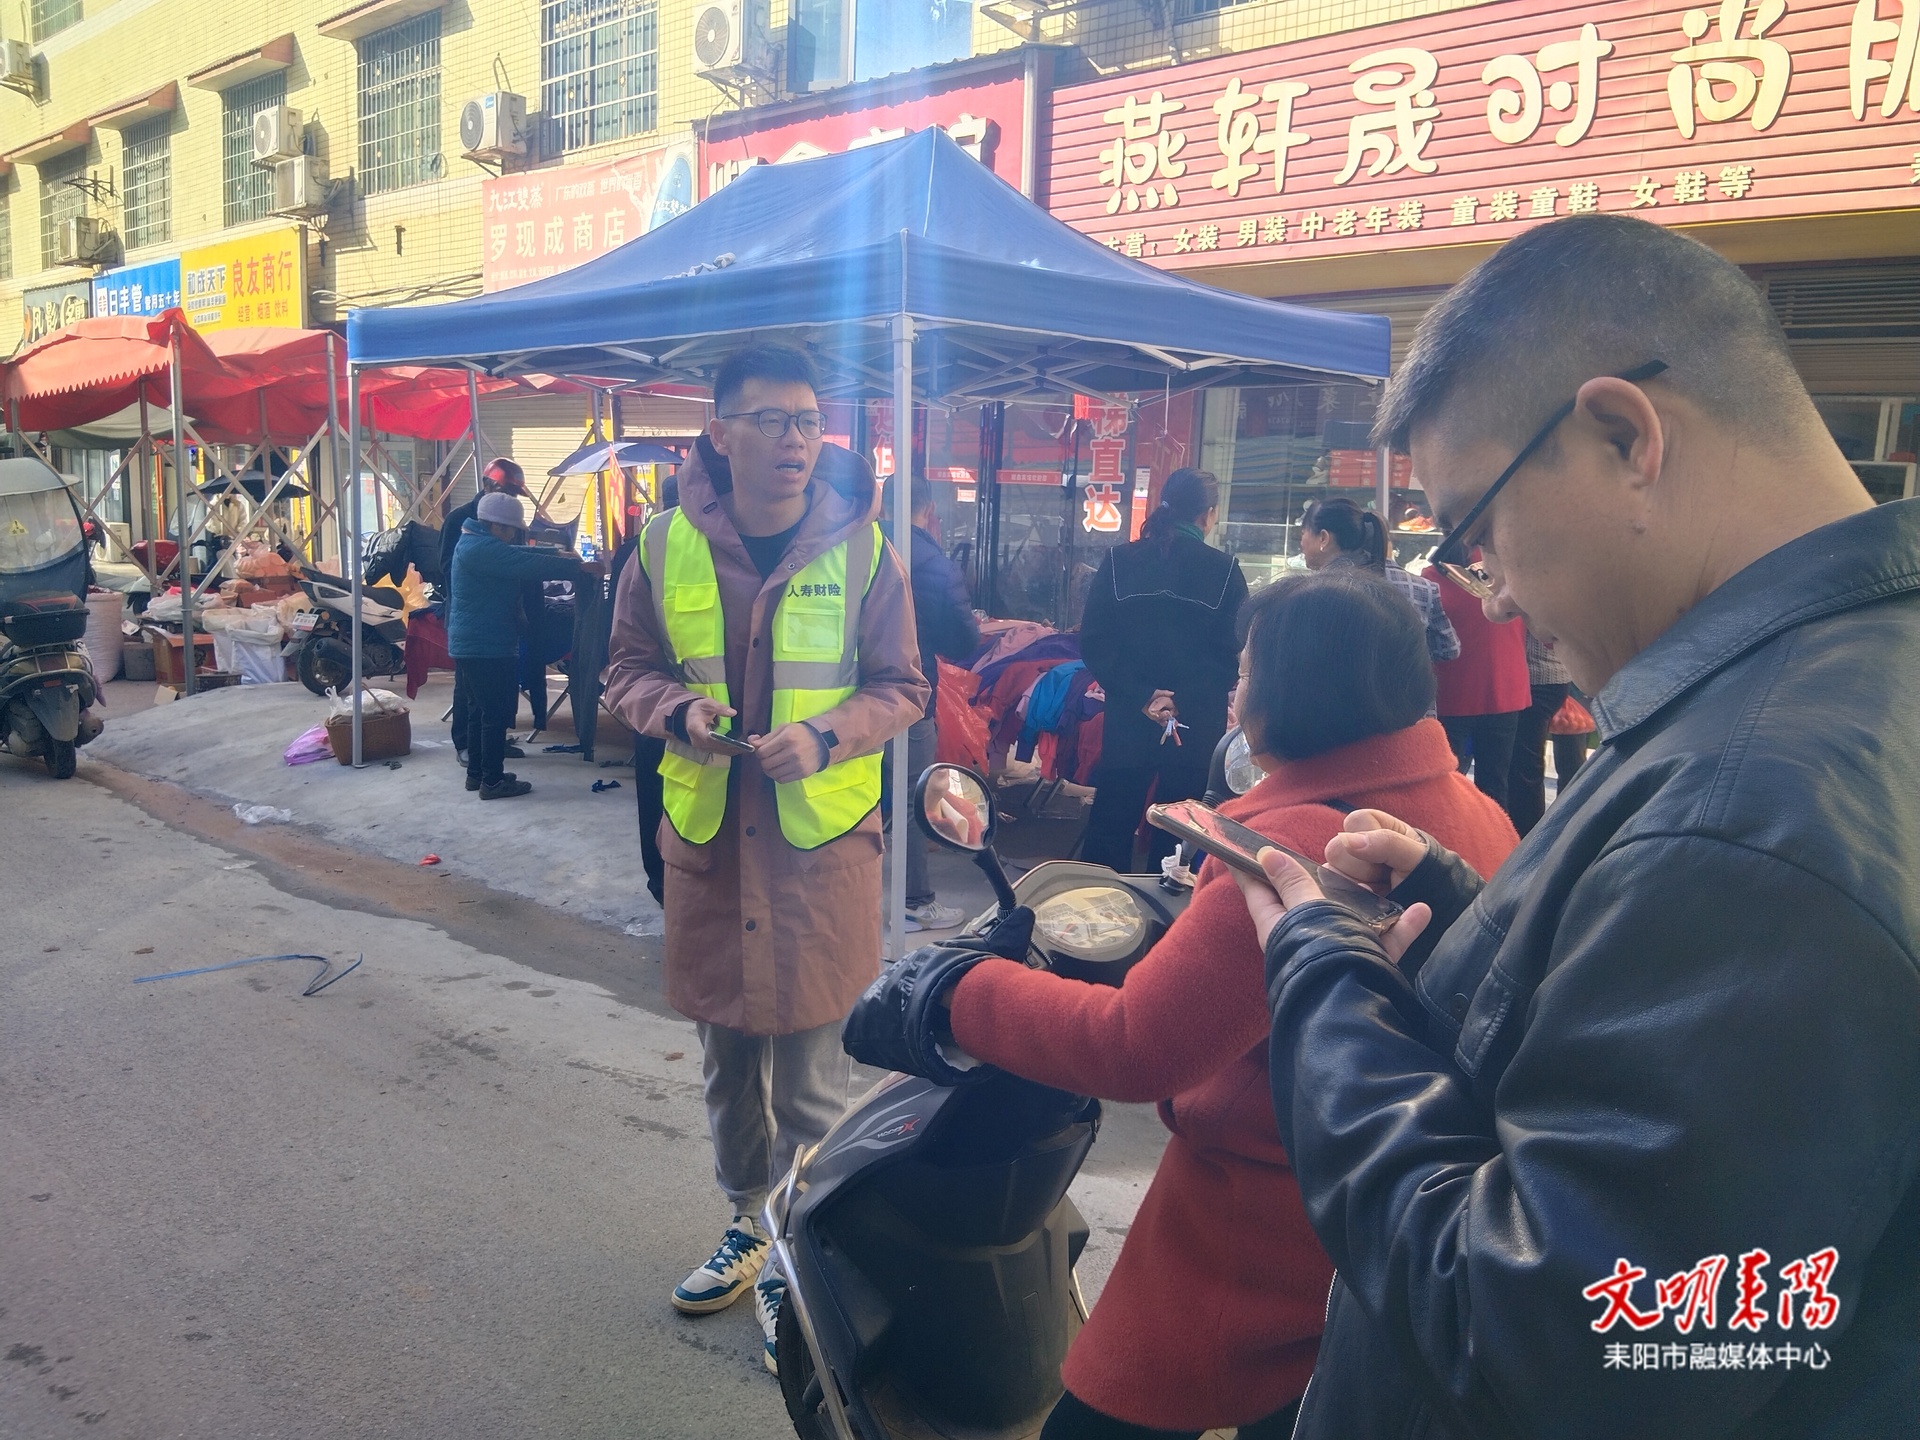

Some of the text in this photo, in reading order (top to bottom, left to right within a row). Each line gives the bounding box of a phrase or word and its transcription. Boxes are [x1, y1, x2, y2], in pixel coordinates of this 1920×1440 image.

[1173, 224, 1219, 253] 女装
[1237, 216, 1287, 247] 男装
[1300, 201, 1424, 239] 中老年装
[1450, 181, 1600, 227] 童装童鞋
[1629, 164, 1754, 208] 女鞋等
[490, 207, 626, 262] 罗现成商店
[232, 250, 293, 299] 良友商行
[109, 283, 143, 317] 日丰管
[787, 584, 841, 598] 人寿财险
